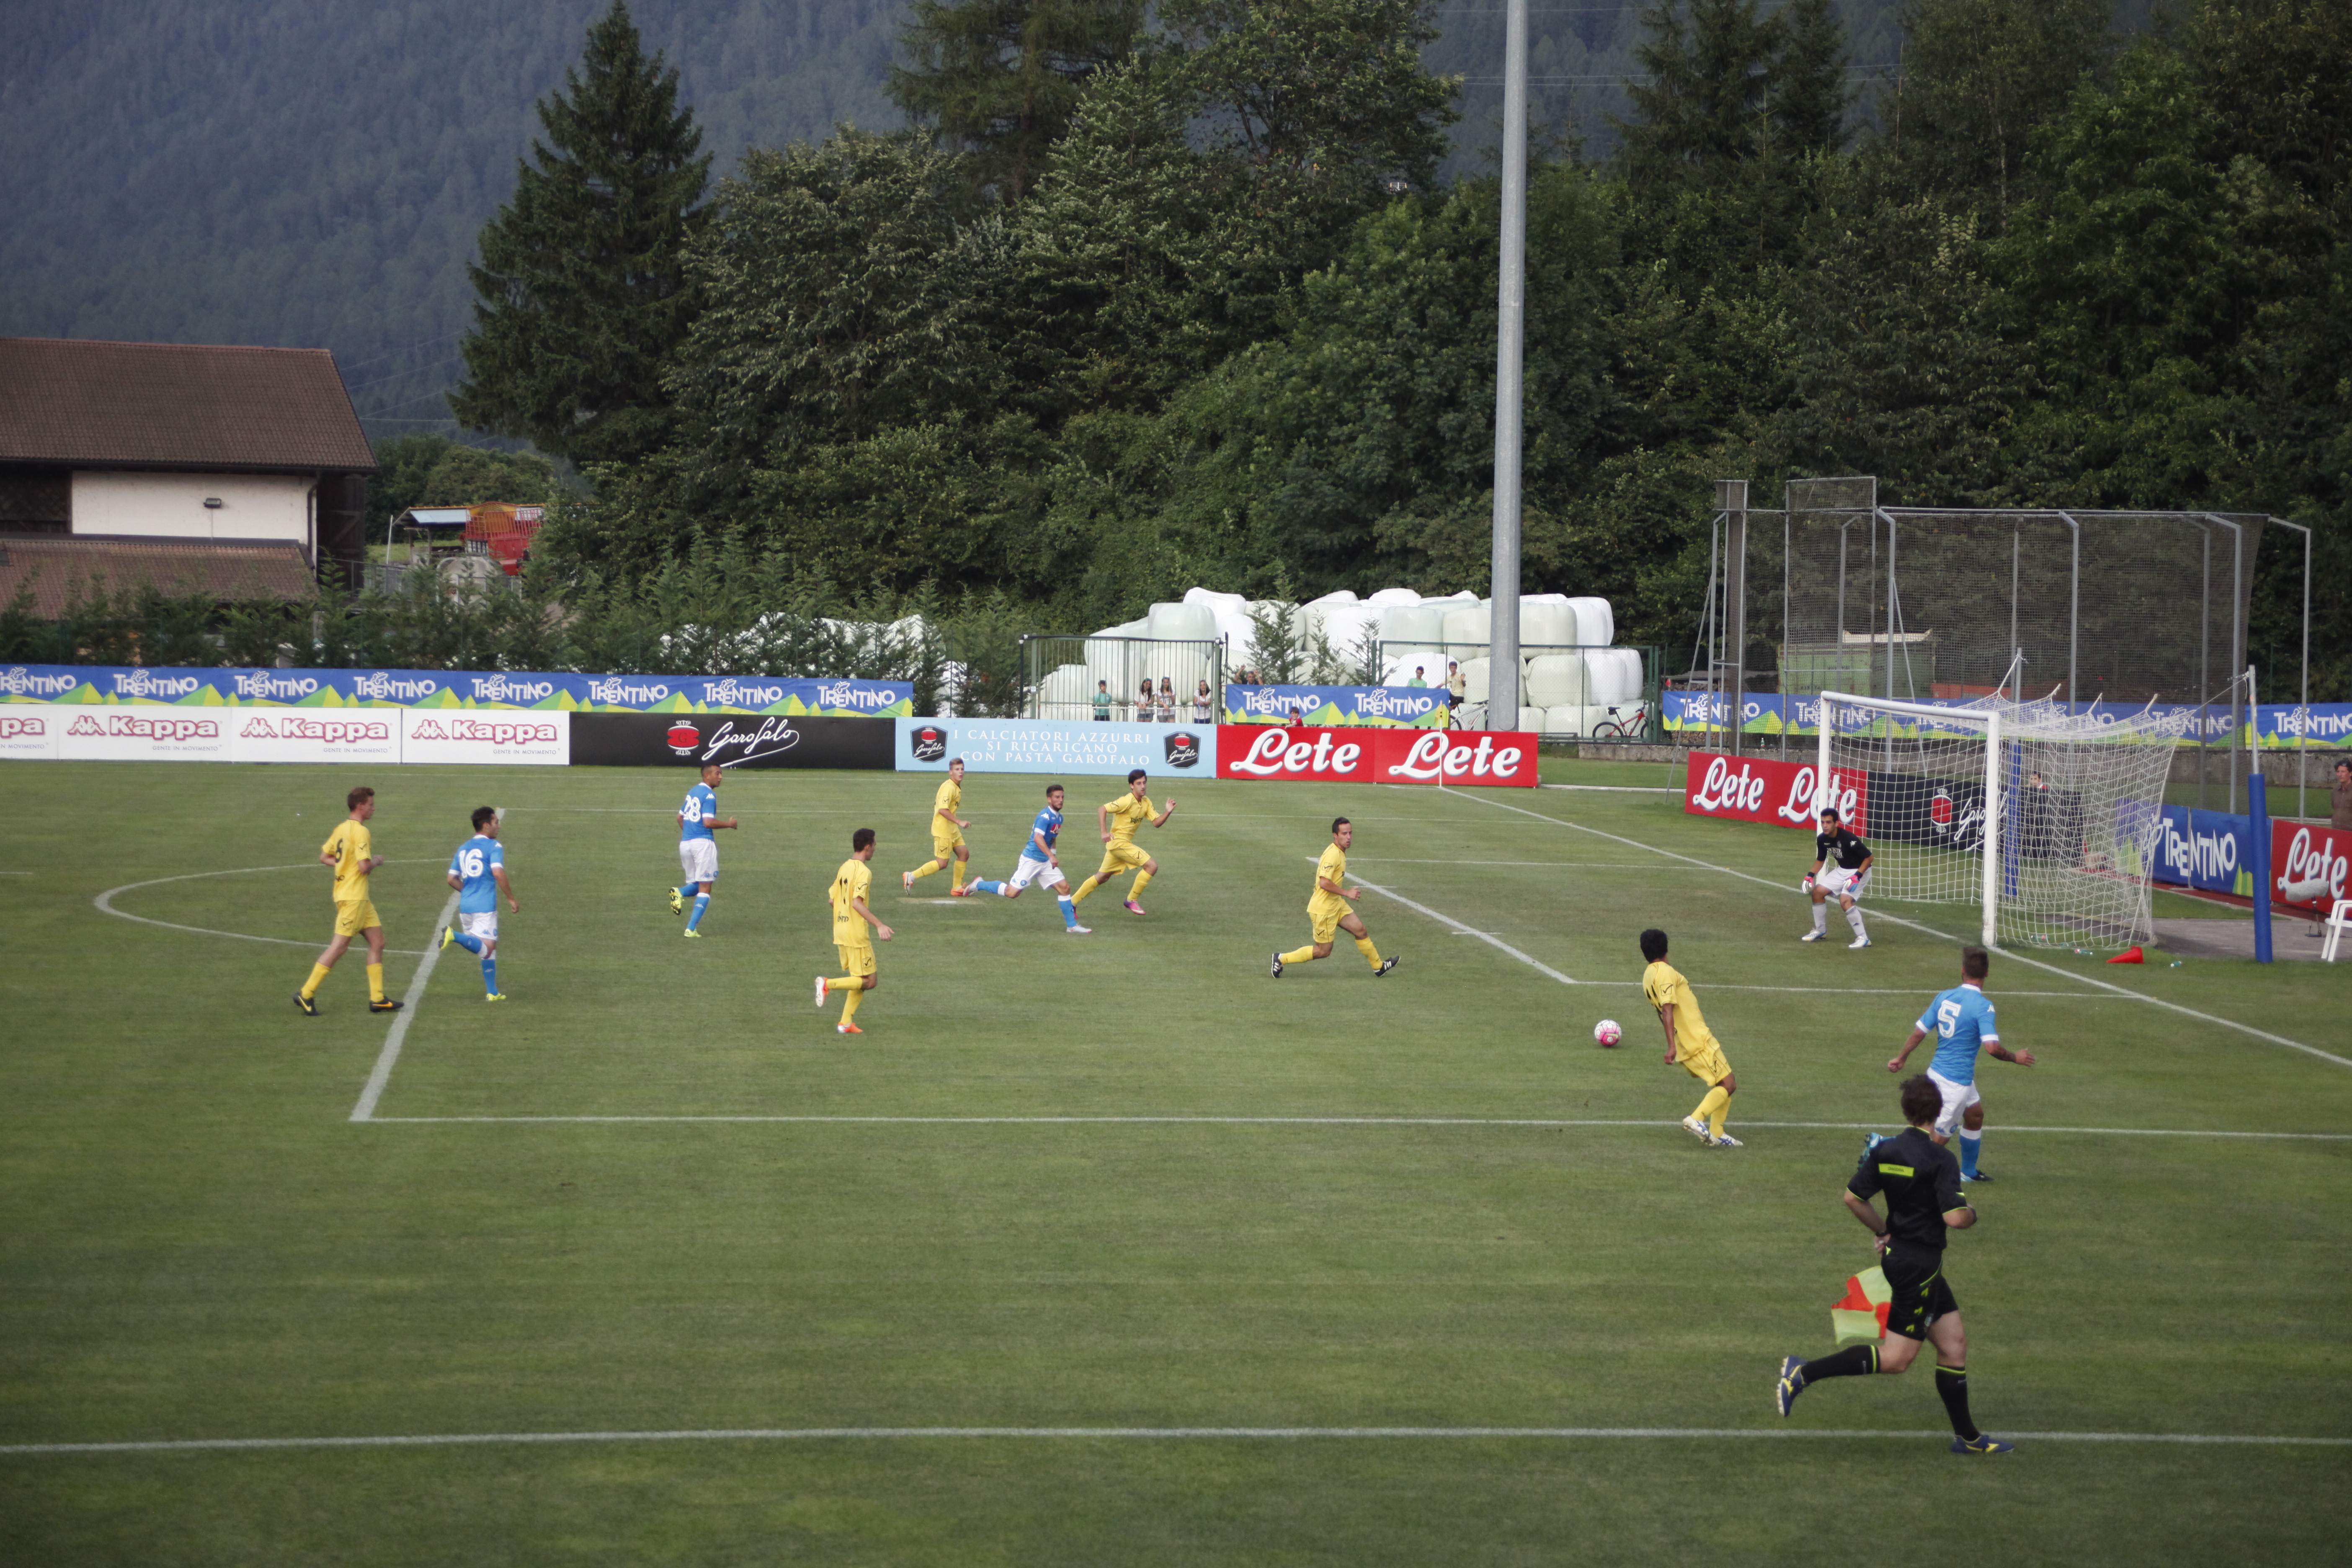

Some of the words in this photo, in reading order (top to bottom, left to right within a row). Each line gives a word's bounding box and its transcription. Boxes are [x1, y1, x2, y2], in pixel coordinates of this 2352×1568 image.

[0, 672, 77, 694] RENTINO
[113, 674, 198, 696] TRENTINO
[235, 675, 317, 698] TRENTINO
[354, 676, 436, 699] TRENTINO
[471, 678, 553, 701] TRENTINO
[588, 681, 668, 704] TRENTINO
[703, 683, 782, 705] TRENTINO
[817, 686, 895, 708] TRENTINO
[1243, 691, 1321, 714] TRENTINO
[1354, 693, 1433, 715] TRENTINO
[110, 716, 218, 740] Kappa
[282, 718, 388, 743] Kappa
[452, 720, 557, 744] Kappa
[954, 730, 958, 739] I
[968, 730, 1070, 741] CALCIATORI
[1079, 732, 1150, 743] AZZURRI
[701, 717, 799, 767] Garofalo
[914, 742, 945, 759] Garofalo
[987, 741, 1001, 750] SI
[1011, 742, 1117, 753] RICARICANO
[1230, 728, 1361, 775] Lete
[960, 751, 995, 761] CON
[1006, 752, 1053, 763] PASTA
[1063, 753, 1150, 765] GAROFALO
[1167, 748, 1198, 765] Garofalo
[1388, 731, 1522, 779] Lete
[1693, 757, 1765, 812] Lete
[683, 794, 701, 822] 28
[2163, 818, 2236, 881] TRENTINO
[459, 848, 484, 878] 16
[2277, 828, 2347, 900] Lete
[1937, 999, 1962, 1038] 5
